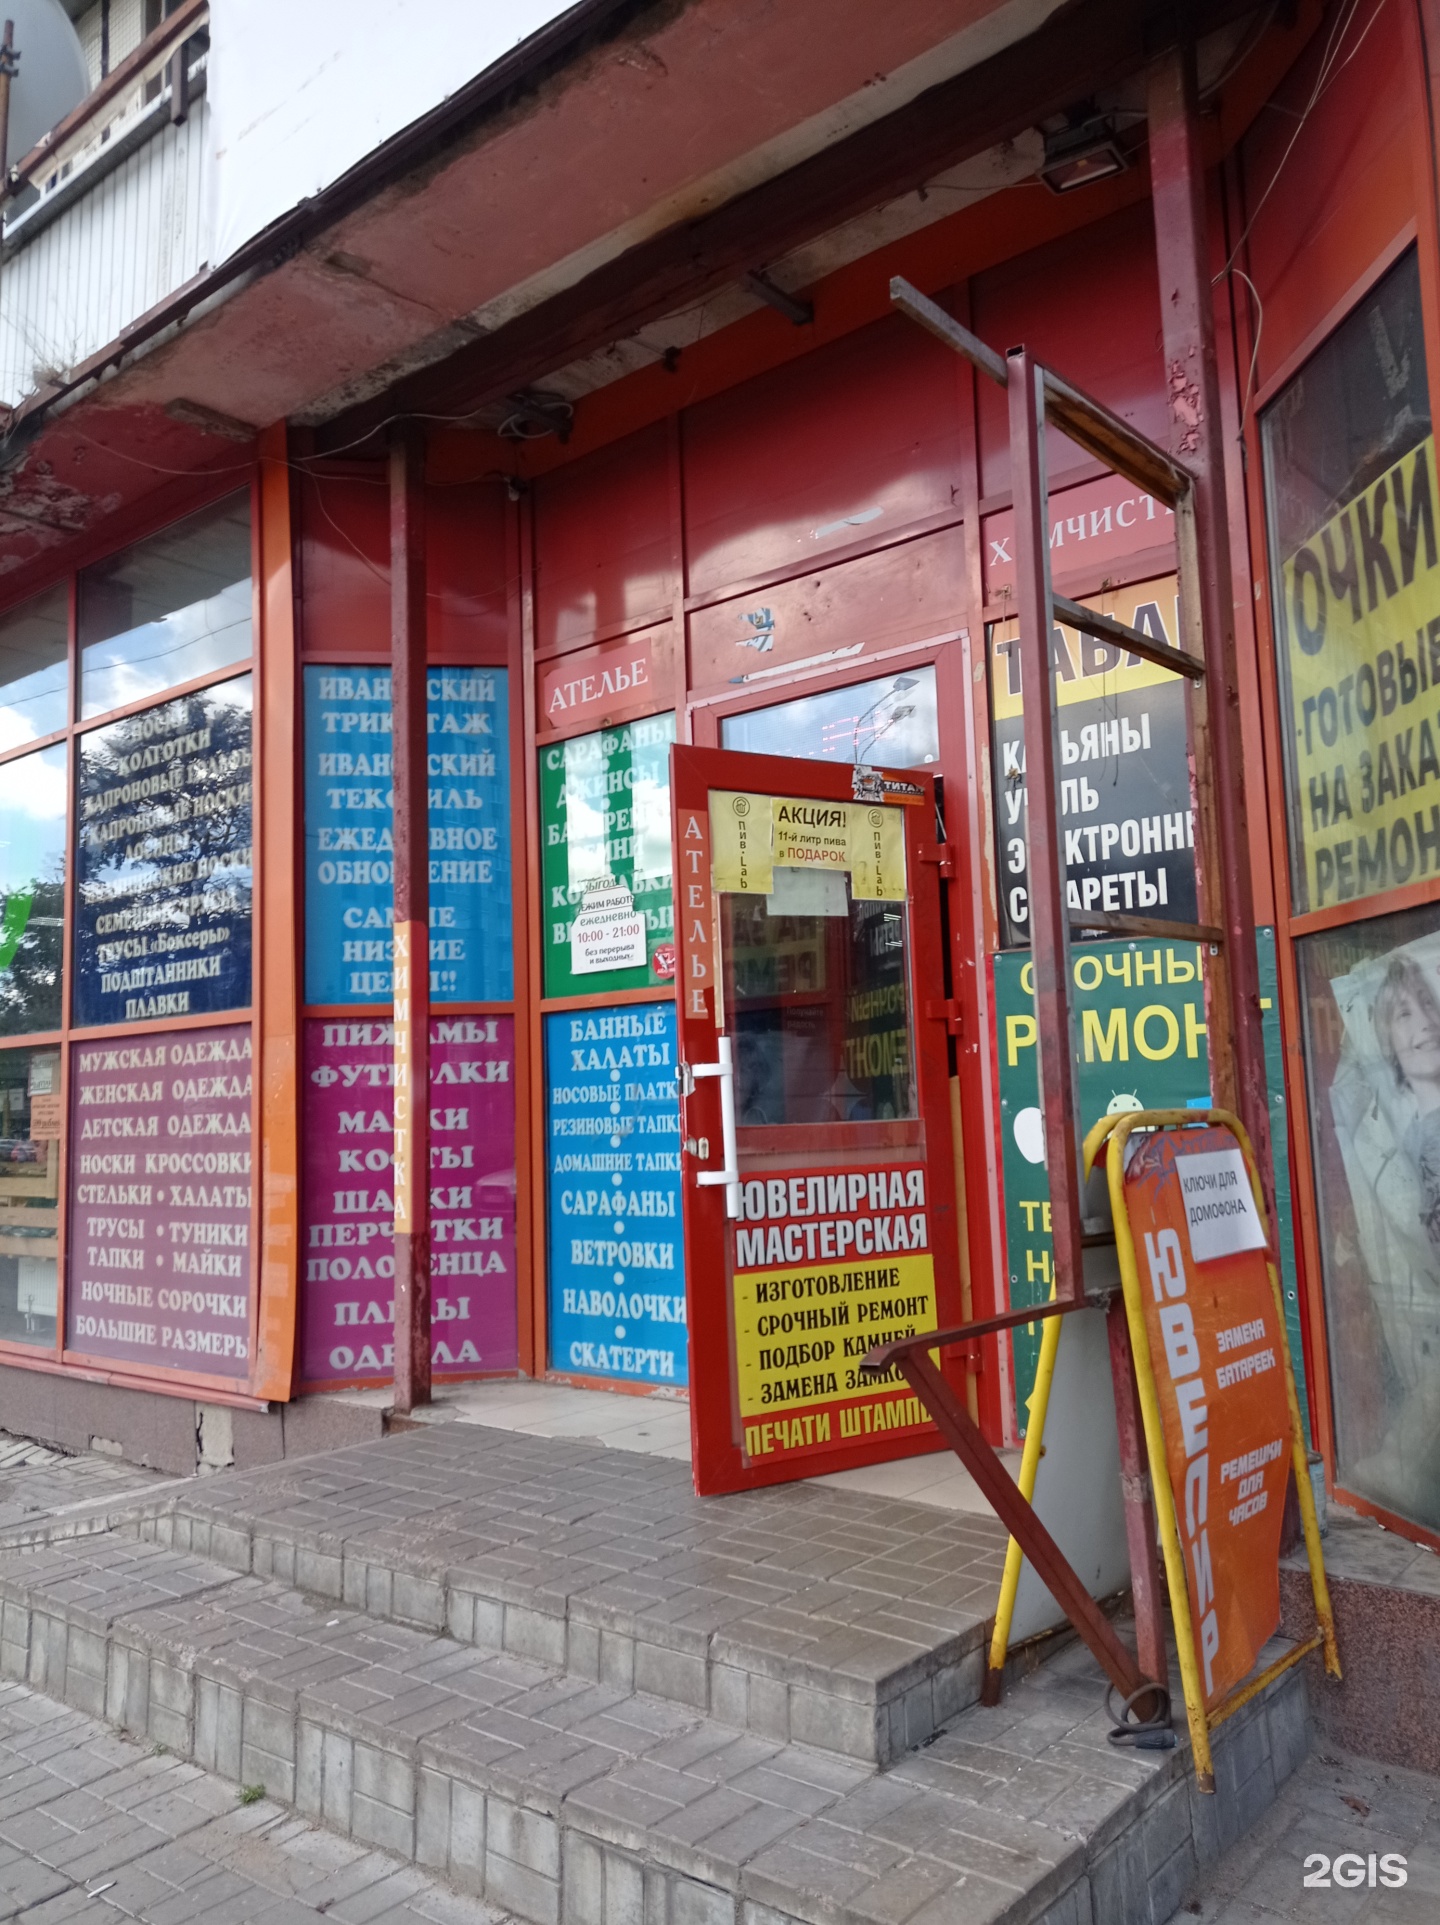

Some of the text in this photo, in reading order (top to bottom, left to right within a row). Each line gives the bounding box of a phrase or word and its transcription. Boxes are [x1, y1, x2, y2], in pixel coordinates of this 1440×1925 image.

[990, 495, 1175, 566] ХМЧИСТ
[1293, 446, 1438, 656] ОЧКИ
[995, 595, 1180, 696] ТАБА
[318, 674, 496, 702] ИВАНСКИЙ
[549, 658, 649, 714] АТЕЛЬЕ
[322, 712, 493, 733] ТРИКТАЖ
[117, 729, 211, 776] КОЛГОТКИ
[546, 718, 673, 770] САРАФАНЫ
[1003, 713, 1151, 776] КЬЯНЫ
[318, 749, 496, 776] ИВАНСКИЙ
[1308, 709, 1440, 832] НА ЗАКА
[84, 767, 185, 816] КАПРОНОВЫЕ
[193, 783, 252, 816] НОСКИ
[327, 788, 484, 809] ТЕКИЛЬ
[556, 761, 659, 808] ДЖИНСЫ
[1005, 777, 1099, 825] УЛЬ
[778, 806, 846, 828] АКЦИЯ!
[318, 827, 497, 853] ЕЖЕДВНОЕ
[778, 831, 846, 846] 11-й литр пива
[1007, 811, 1194, 874] ЭКТРОНН
[779, 848, 846, 862] в ПОДАРОК
[1314, 804, 1440, 907] РЕМОН
[318, 860, 493, 885] ОБНОЕНИЕ
[580, 900, 605, 912] ЕЖИМ
[1009, 868, 1168, 923] САРЕТЫ
[580, 911, 637, 926] ежедневно
[684, 816, 708, 1014] АТЕЛЬЕ
[577, 930, 603, 943] 10:00
[612, 924, 640, 938] 21:00
[97, 936, 149, 964] ТРУСЫ
[585, 944, 635, 957] без перерыва
[101, 955, 221, 994] ПОДШТАННИКИ
[1020, 946, 1204, 995] СОЧНЫ
[125, 992, 190, 1019] ПЛАВКИ
[322, 1021, 499, 1047] ПИЖМЫ
[570, 1012, 667, 1042] БАННЫЕ
[1006, 998, 1272, 1066] РМОН
[79, 1037, 252, 1073] МУЖСКАЯ ОДЕЖДА
[571, 1043, 670, 1072] ХАЛАТЫ
[79, 1074, 252, 1105] ЖЕНСКАЯ ОДЕЖДА
[310, 1060, 510, 1088] ФУТЛКИ
[393, 934, 410, 1219] ХИМЧИСТКА
[553, 1081, 679, 1104] НОСОВЫЕ ПЛАТК
[81, 1116, 159, 1141] ДЕТСКАЯ
[167, 1112, 251, 1138] ОДЕЖДА
[338, 1108, 469, 1134] МАКИ
[553, 1116, 634, 1136] РЕЗИНОВЫЕ
[80, 1154, 135, 1174] НОСКИ
[554, 1153, 633, 1174] ДОМАШНИЕ
[77, 1184, 252, 1208] СТЕЛЬКИ ХАЛАТЫ
[736, 1169, 925, 1222] ЮВЕЛИРНАЯ
[1183, 1170, 1238, 1193] КЛЮЧИ ДЛЯ
[332, 1186, 472, 1214] ШАКИ
[560, 1190, 676, 1217] САРАФАНЫ
[1189, 1198, 1247, 1227] ДОМОФОНА
[87, 1217, 248, 1247] ТРУСЫ ТУНИКИ
[308, 1217, 503, 1248] ПЕРЧТКИ
[735, 1213, 928, 1268] МАСТЕРСКАЯ
[87, 1246, 242, 1277] ТАПКИ МАЙКИ
[570, 1240, 674, 1271] ВЕТРОВКИ
[81, 1280, 246, 1318] НОЧНЫЕ СОРОЧКИ
[756, 1268, 900, 1304] ИЗГОТОВЛЕНИЕ
[563, 1289, 687, 1324] НАВОЛОЧКИ
[758, 1302, 850, 1337] СРОЧНЫЙ
[857, 1295, 929, 1323] РЕМОНТ
[76, 1315, 156, 1345] БОЛЬШИЕ
[1216, 1318, 1266, 1353] ЗАМЕНА
[569, 1341, 674, 1377] СКАТЕРТИ
[759, 1341, 835, 1371] ПОДБОР
[1215, 1348, 1276, 1390] БАТАРЕЕК
[761, 1373, 838, 1404] ЗАМЕНА
[745, 1413, 830, 1456] ПЕЧАТИ
[1143, 1228, 1219, 1697] ЮВЕЛИР
[1220, 1439, 1283, 1484] РЕМЕШКИ
[1237, 1470, 1264, 1500] ДЛЯ
[1229, 1491, 1268, 1527] ЧАСОВ
